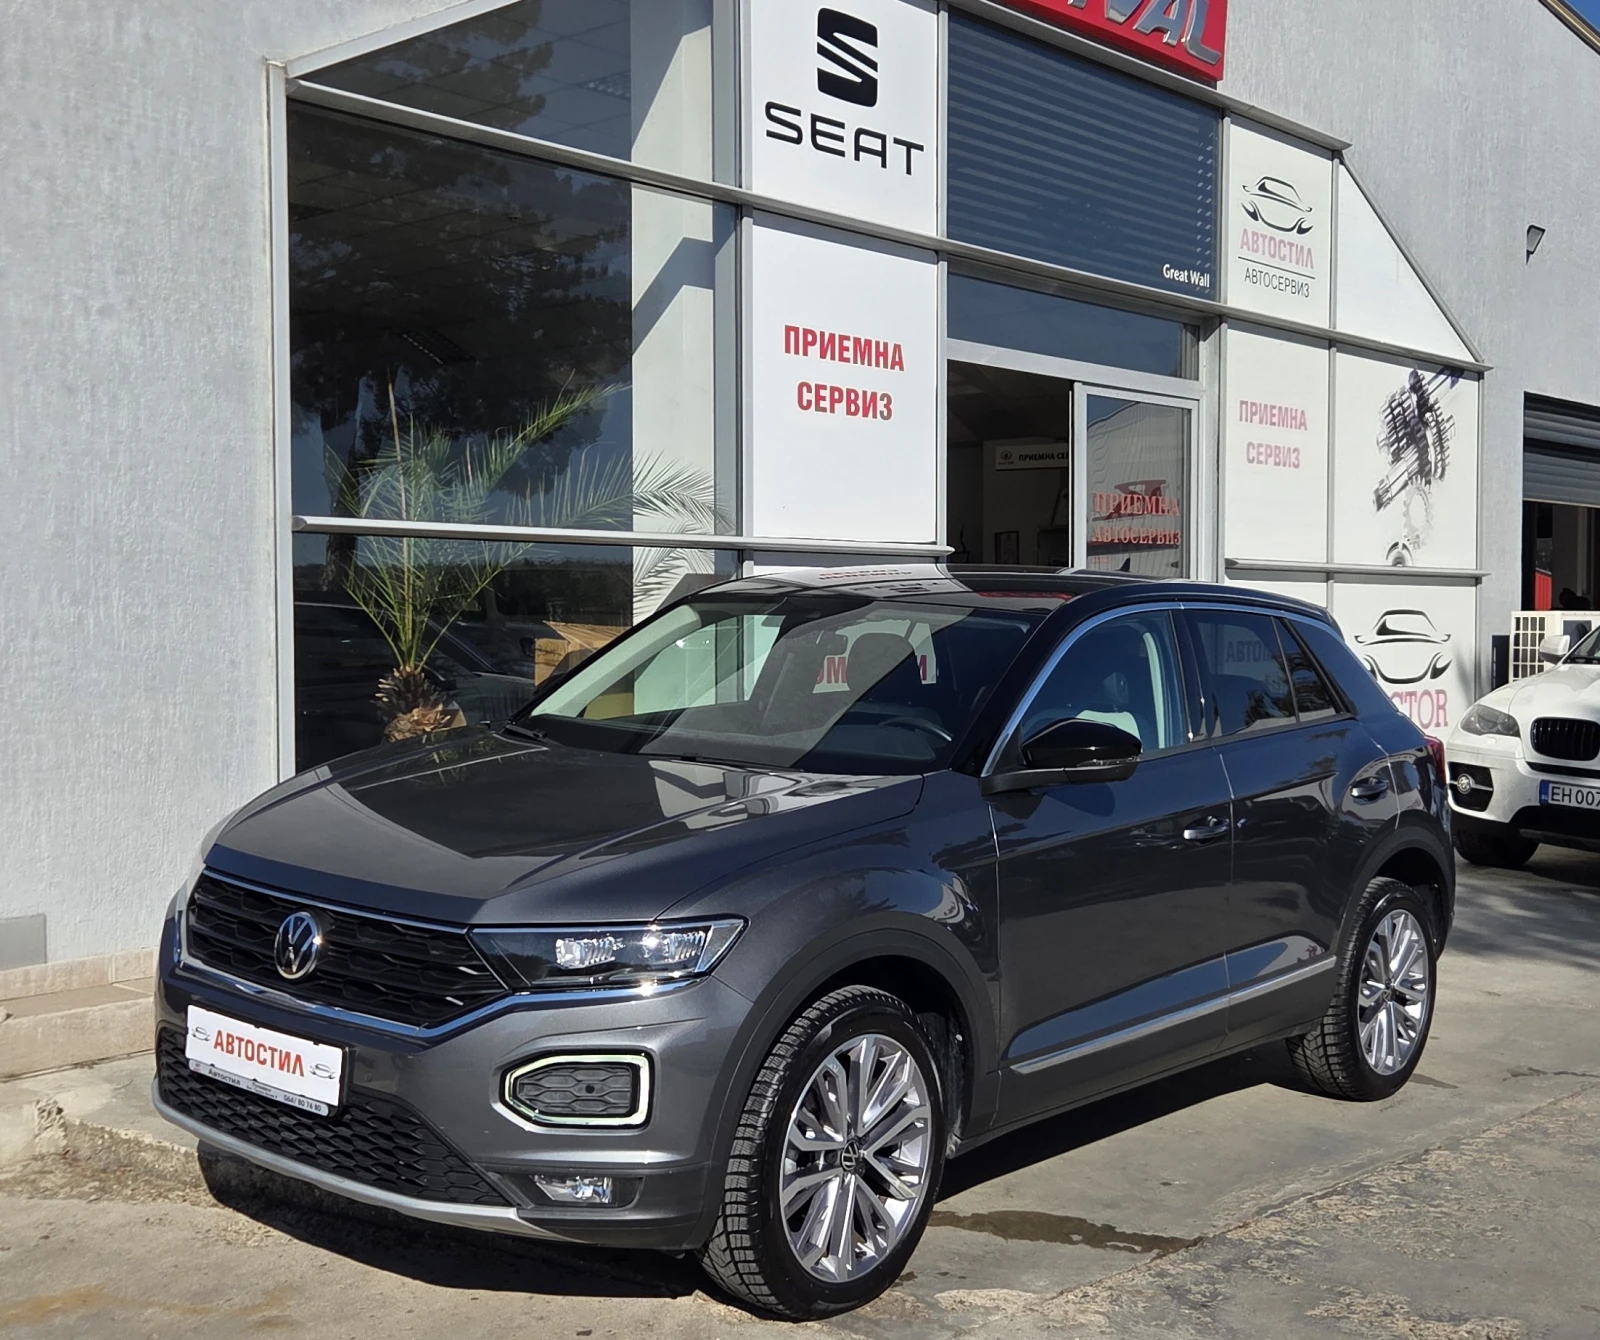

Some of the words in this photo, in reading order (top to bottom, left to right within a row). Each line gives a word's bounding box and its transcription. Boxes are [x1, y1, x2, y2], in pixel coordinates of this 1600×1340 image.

[764, 101, 925, 176] SEAT
[1239, 227, 1315, 270] АВТОСТИЛ
[1163, 263, 1188, 284] Great
[1189, 269, 1210, 288] Wall
[1244, 266, 1310, 298] АВТОСЕРВИЗ
[784, 324, 905, 373] ПРИЕМНА
[796, 381, 893, 421] СЕРВИЗ
[1238, 399, 1308, 431] ПРИЕМНА
[1245, 441, 1301, 470] СЕРВИЗ
[1092, 491, 1180, 517] ПРИЕМНА
[1092, 526, 1182, 545] АВТОСЕРВИЗ
[213, 1029, 305, 1077] АВТОСТИЛ
